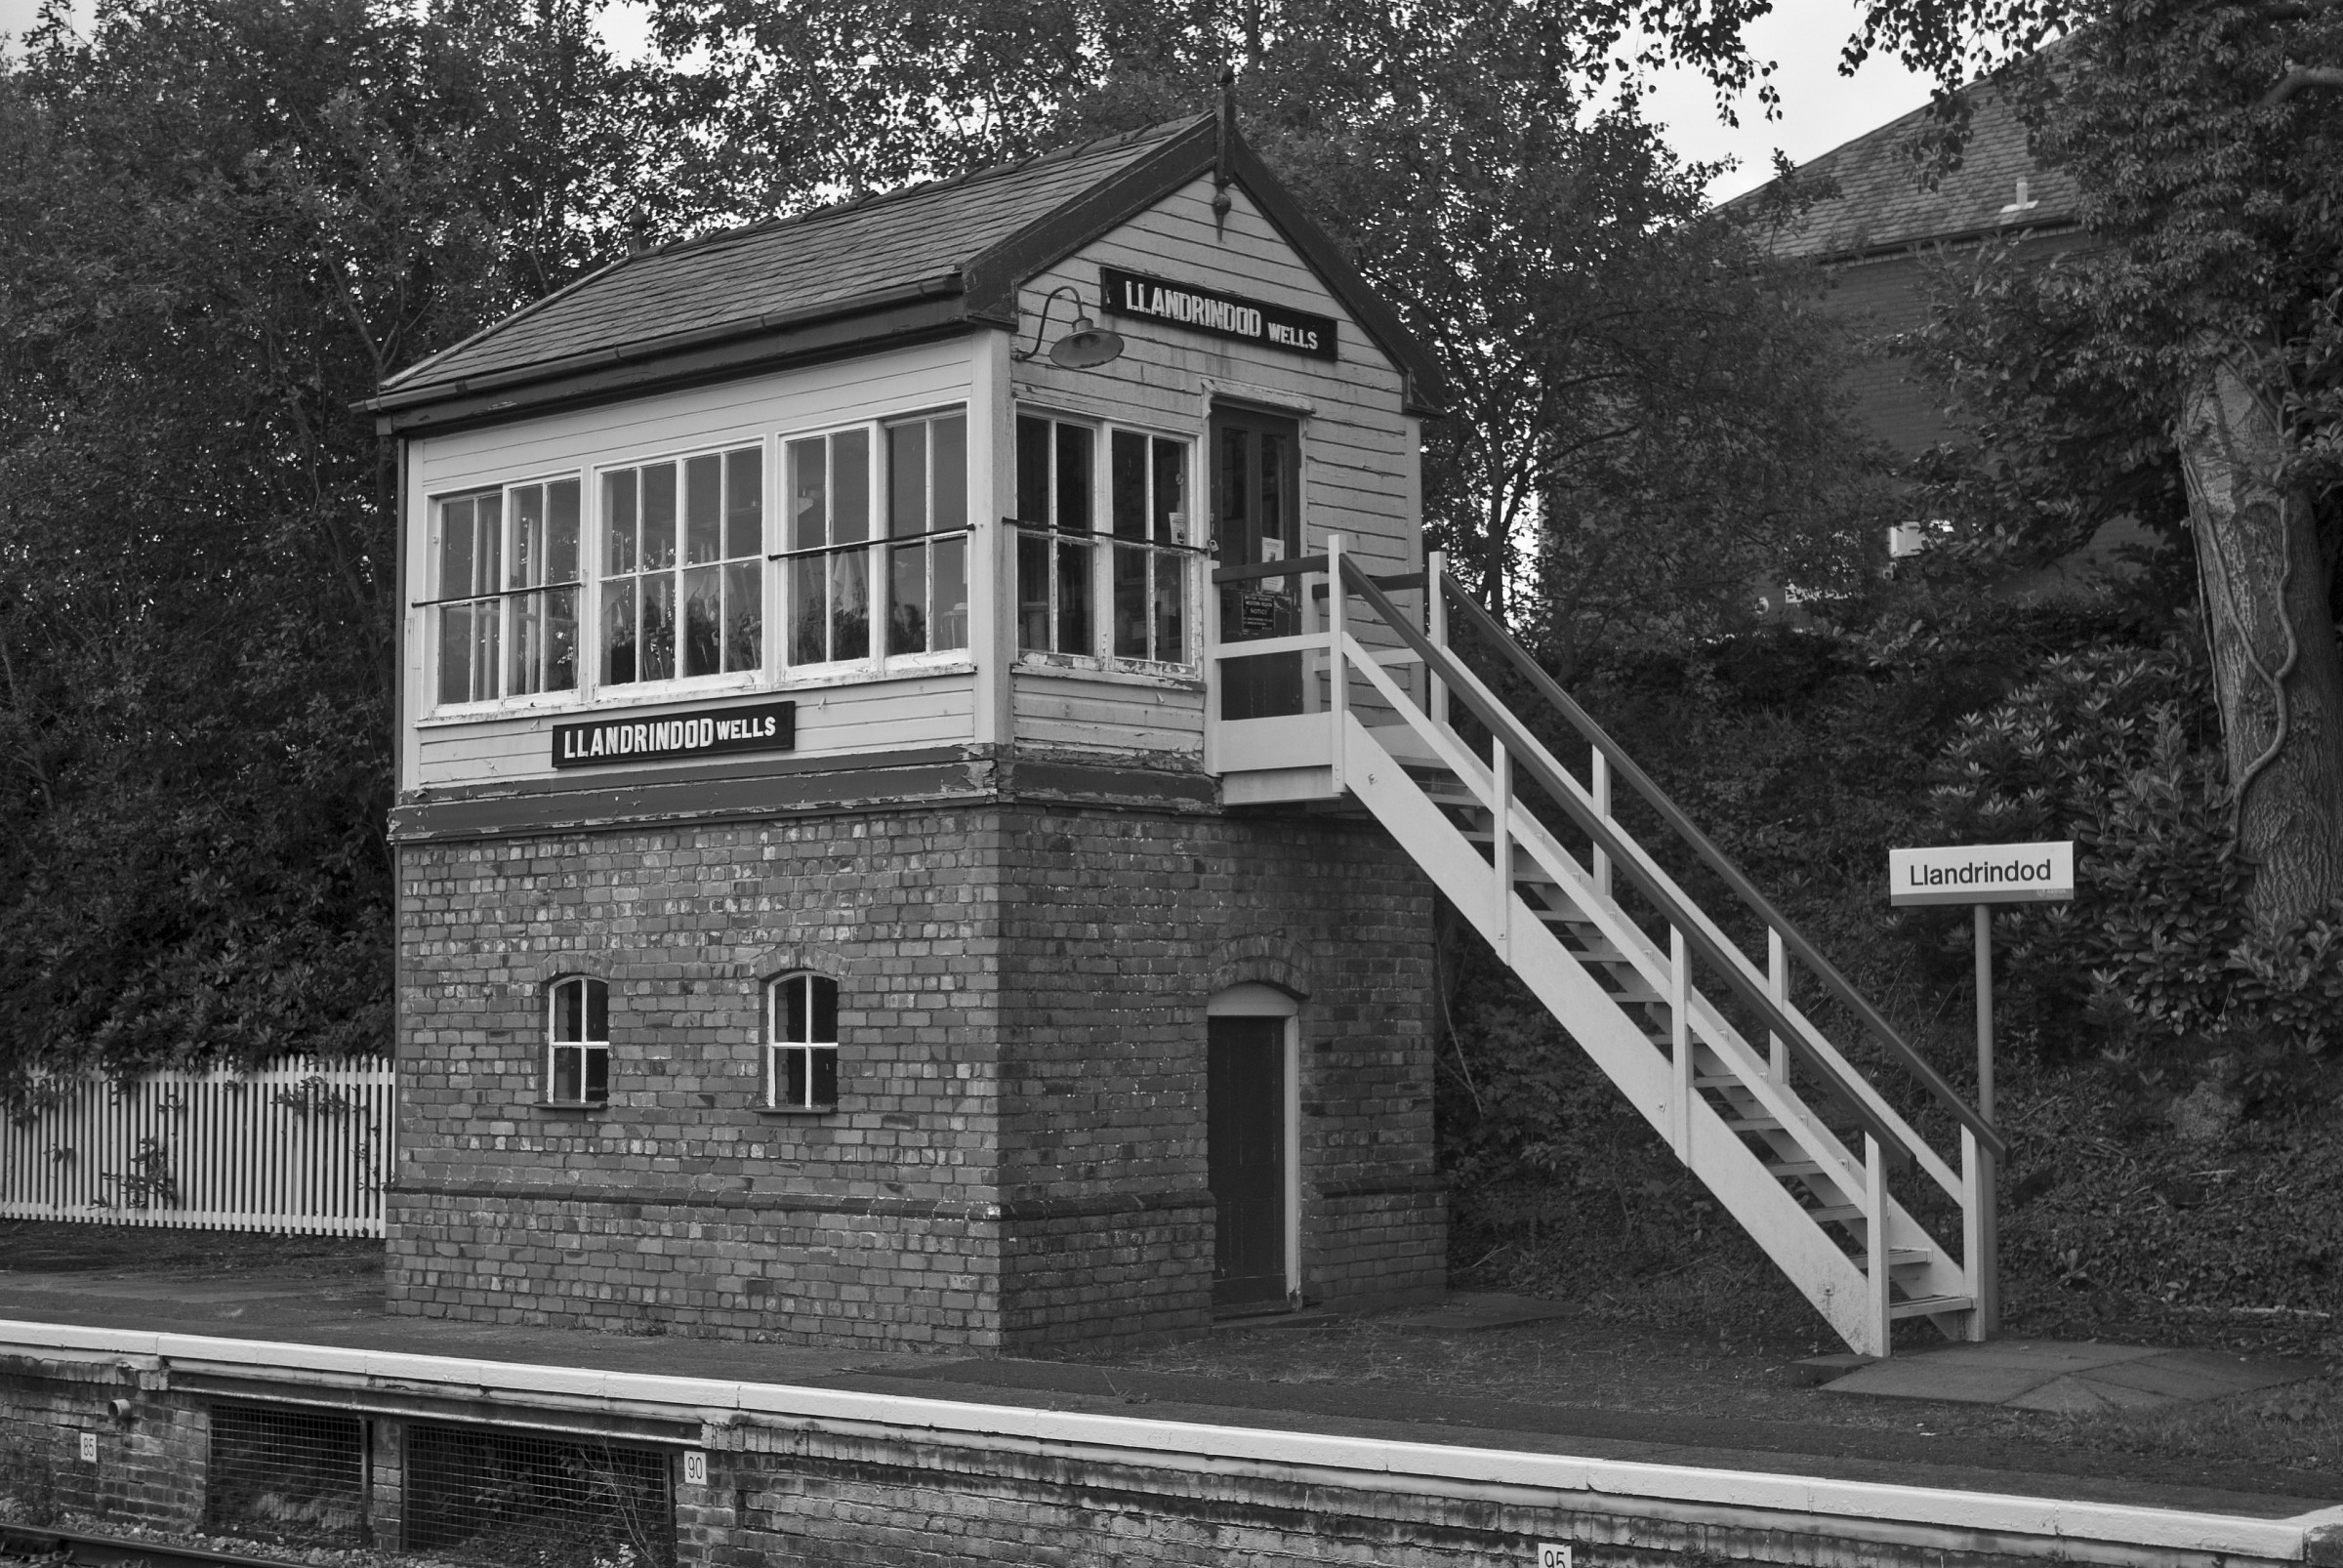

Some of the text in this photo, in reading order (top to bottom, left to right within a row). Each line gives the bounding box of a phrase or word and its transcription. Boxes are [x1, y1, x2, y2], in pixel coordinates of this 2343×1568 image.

[1126, 280, 1318, 351] LLANDRINDOD WELLS
[564, 716, 776, 759] LLANDRINDOD WELLS
[1910, 858, 2051, 887] Llandrindod
[83, 1437, 95, 1457] 85
[688, 1456, 703, 1480] 90
[1544, 1549, 1566, 1568] 95
